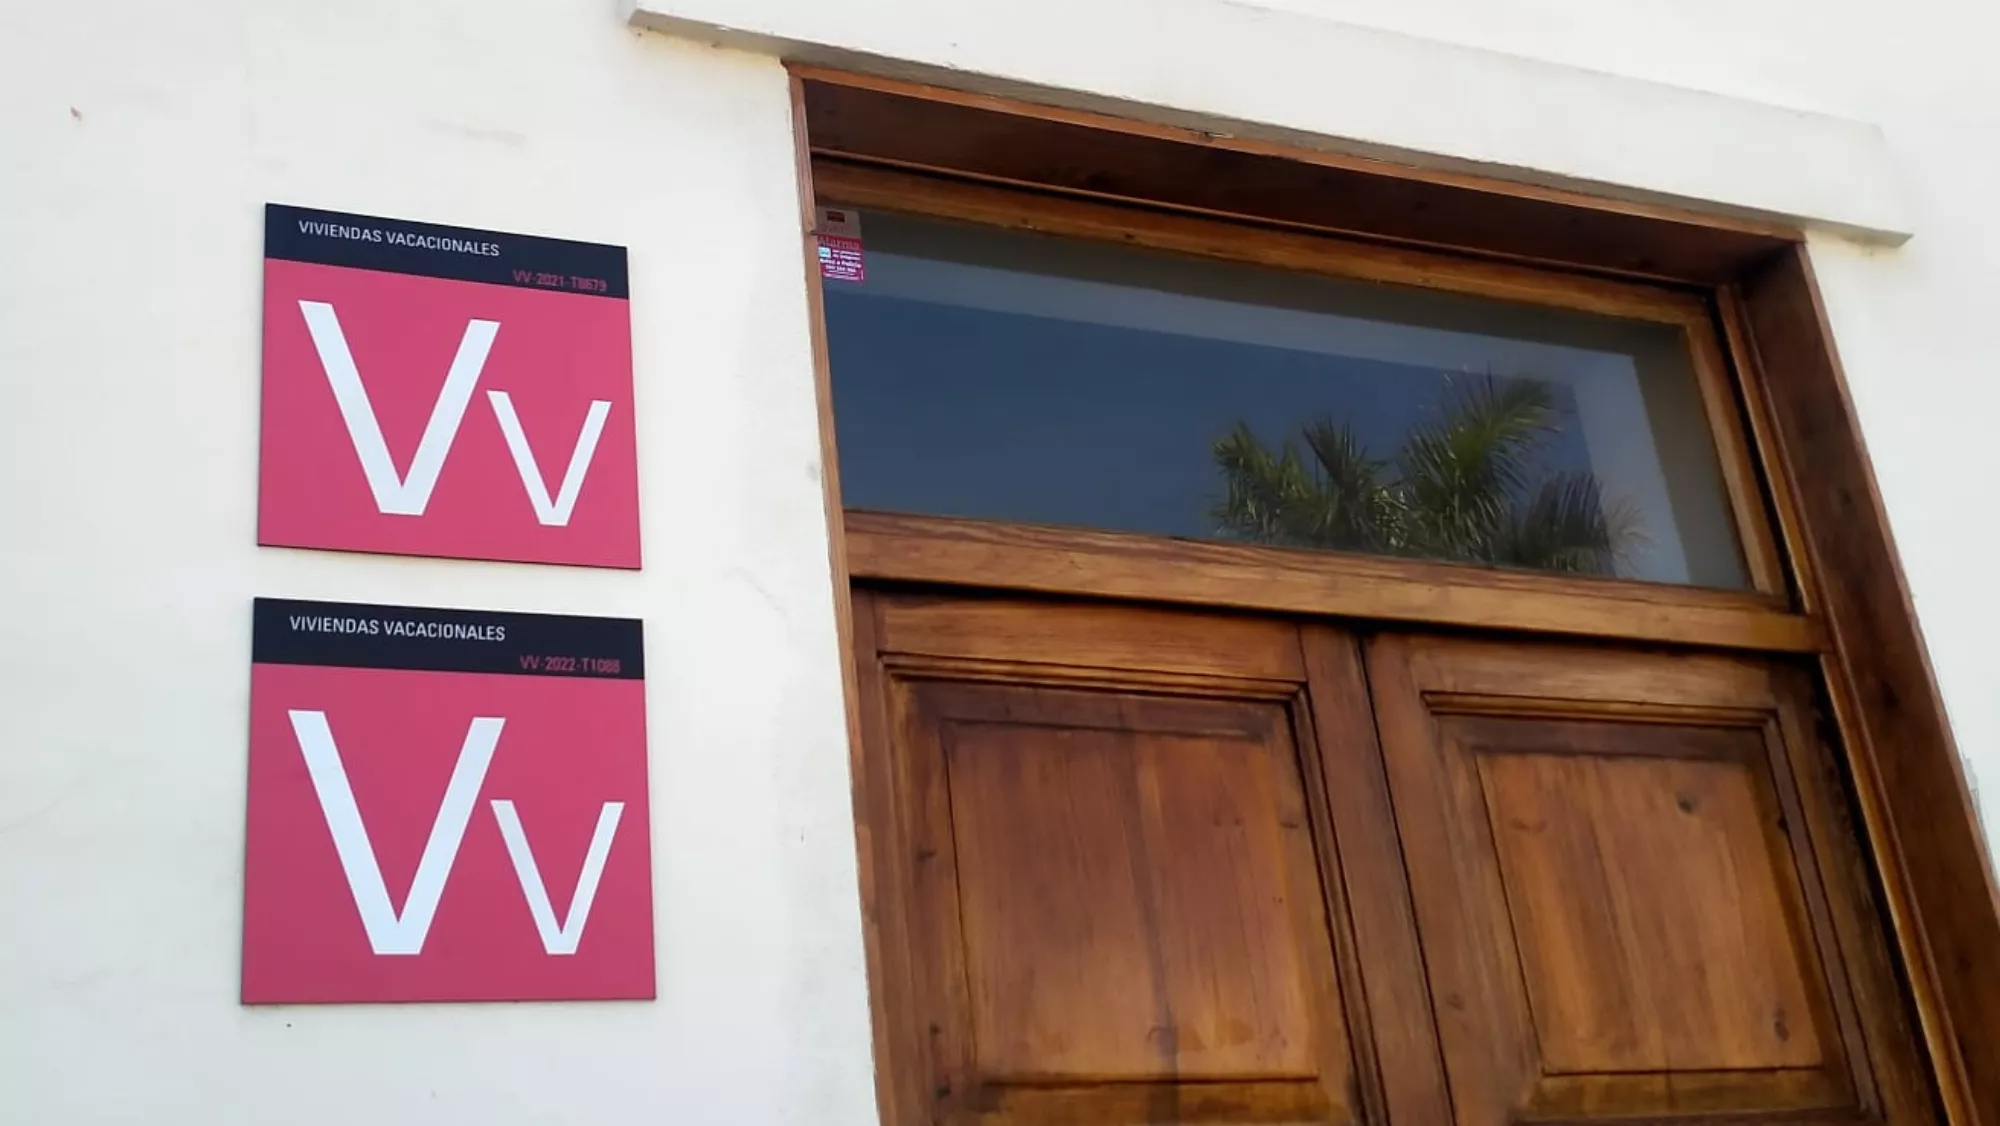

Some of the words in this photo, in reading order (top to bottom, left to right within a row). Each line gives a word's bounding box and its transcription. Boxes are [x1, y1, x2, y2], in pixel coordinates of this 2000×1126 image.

[298, 220, 382, 243] VIVIENDAS
[386, 231, 500, 257] VACACIONALES
[289, 616, 379, 636] VIVIENDAS
[384, 620, 506, 641] VACACIONALES
